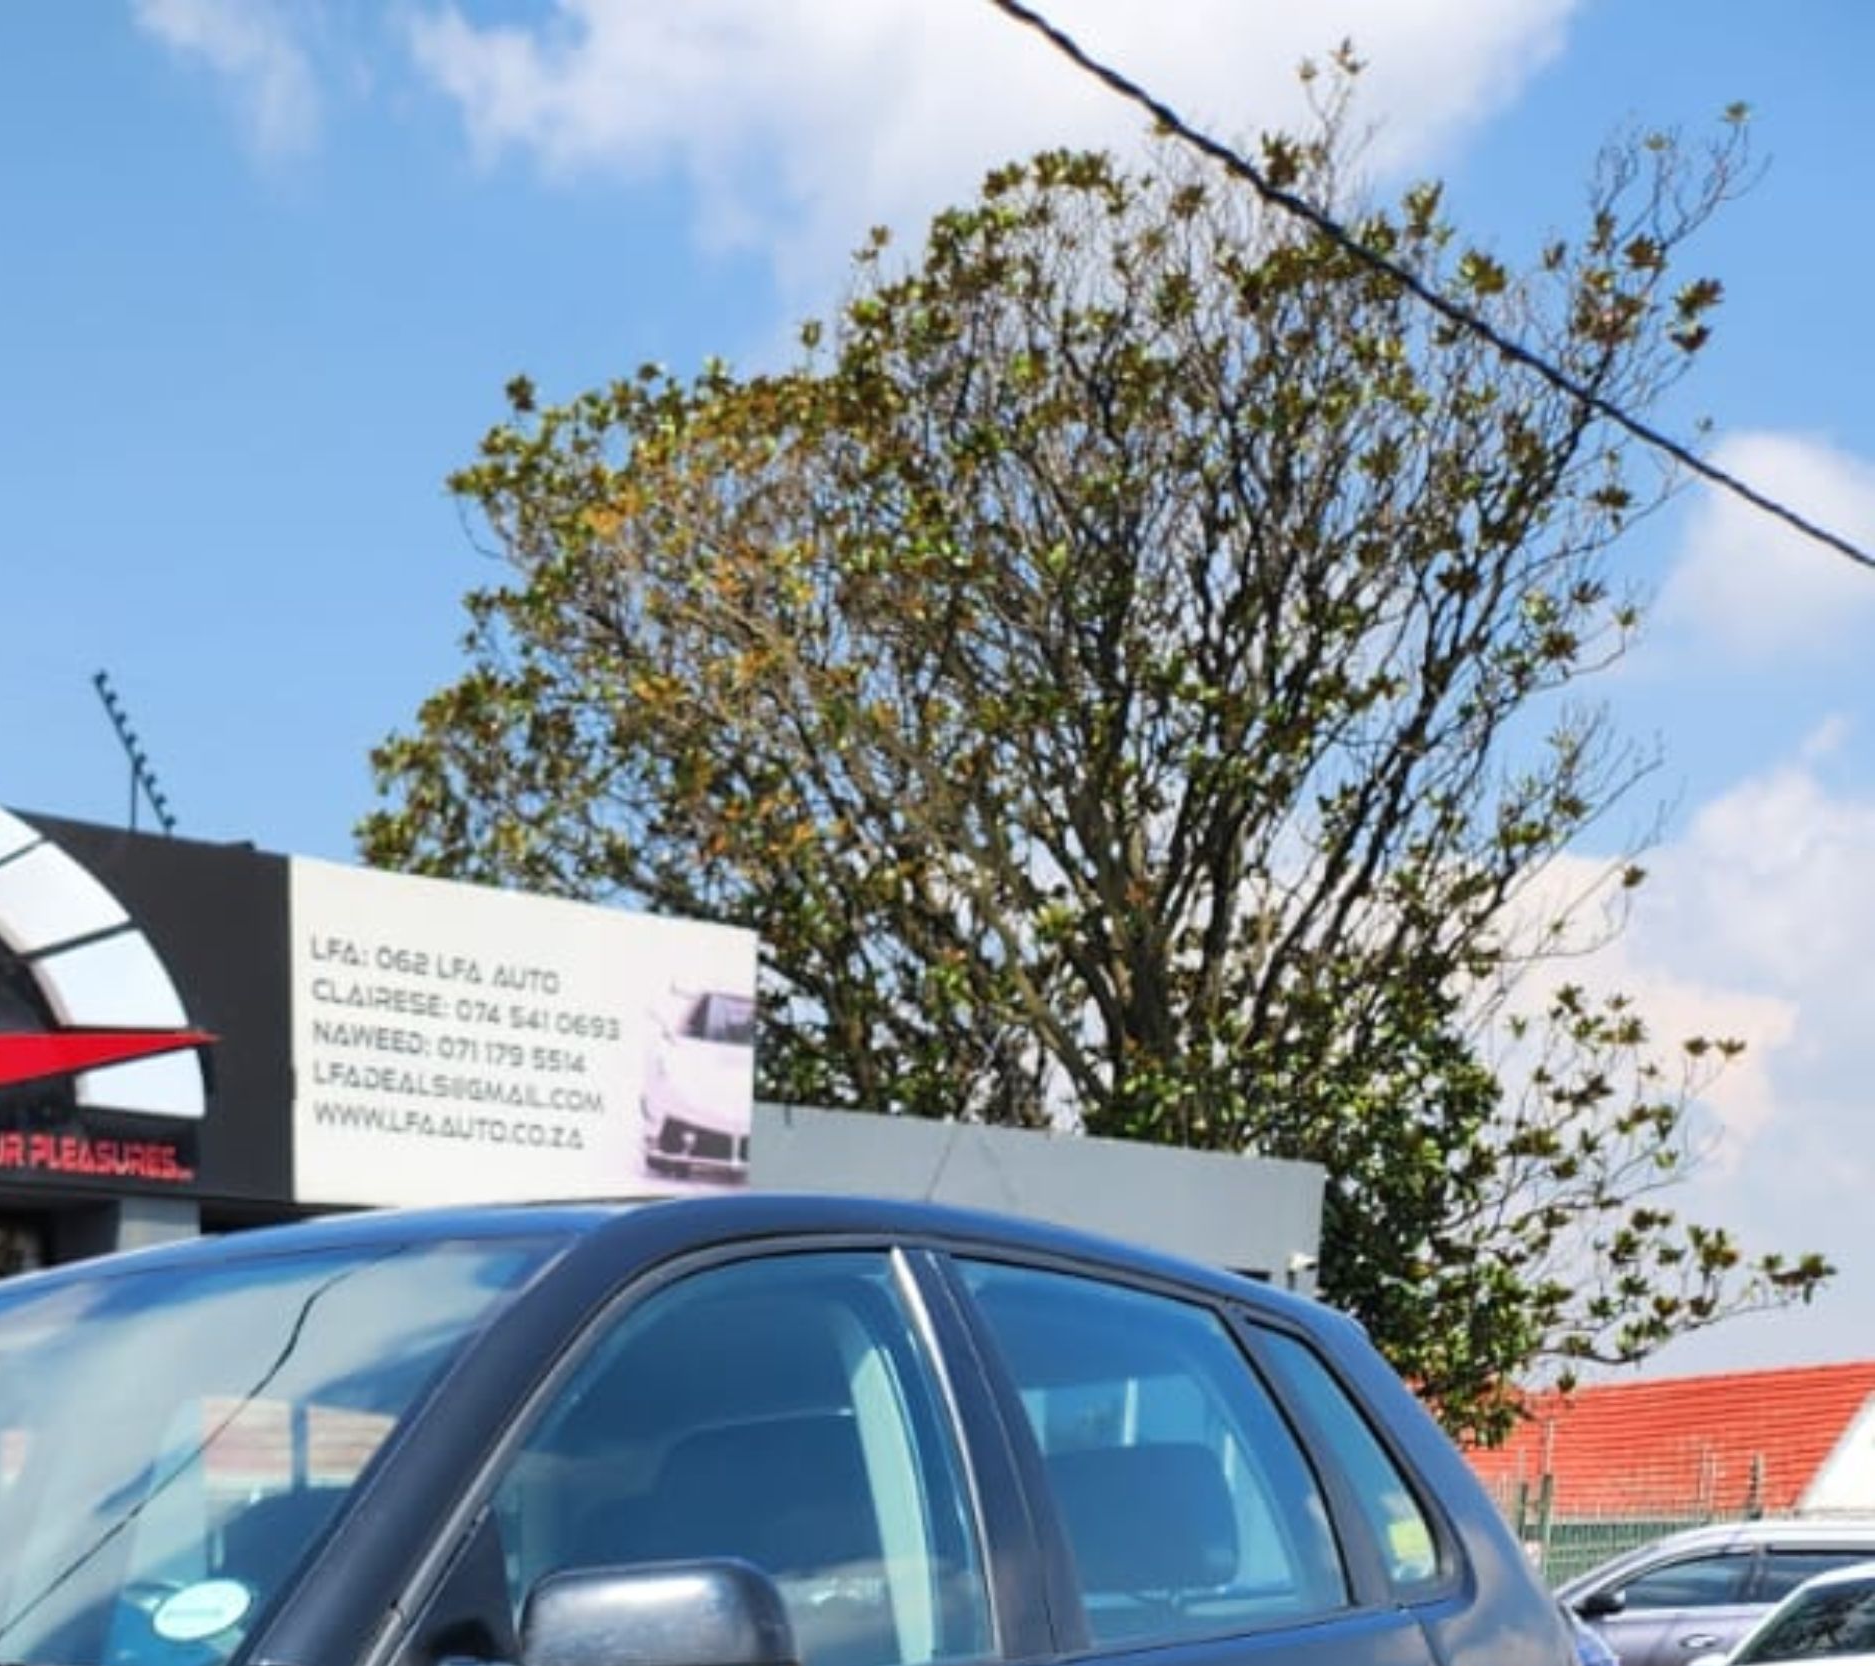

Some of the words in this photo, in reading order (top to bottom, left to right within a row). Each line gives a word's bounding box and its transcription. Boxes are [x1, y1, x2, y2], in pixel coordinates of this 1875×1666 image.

[311, 936, 369, 967] LFA:
[376, 945, 429, 976] 062
[437, 956, 483, 985] LFA
[492, 965, 559, 995] AUTO
[456, 998, 501, 1025] 074
[509, 1005, 549, 1031] 541
[557, 1012, 620, 1041] 0693
[437, 1035, 477, 1061] 071
[485, 1042, 524, 1068] 179
[532, 1046, 587, 1073] 5514
[313, 1062, 603, 1112] LFADEALS@GMAIL.COM
[315, 1102, 585, 1151] WWW.LFAAUTO.CO.ZA
